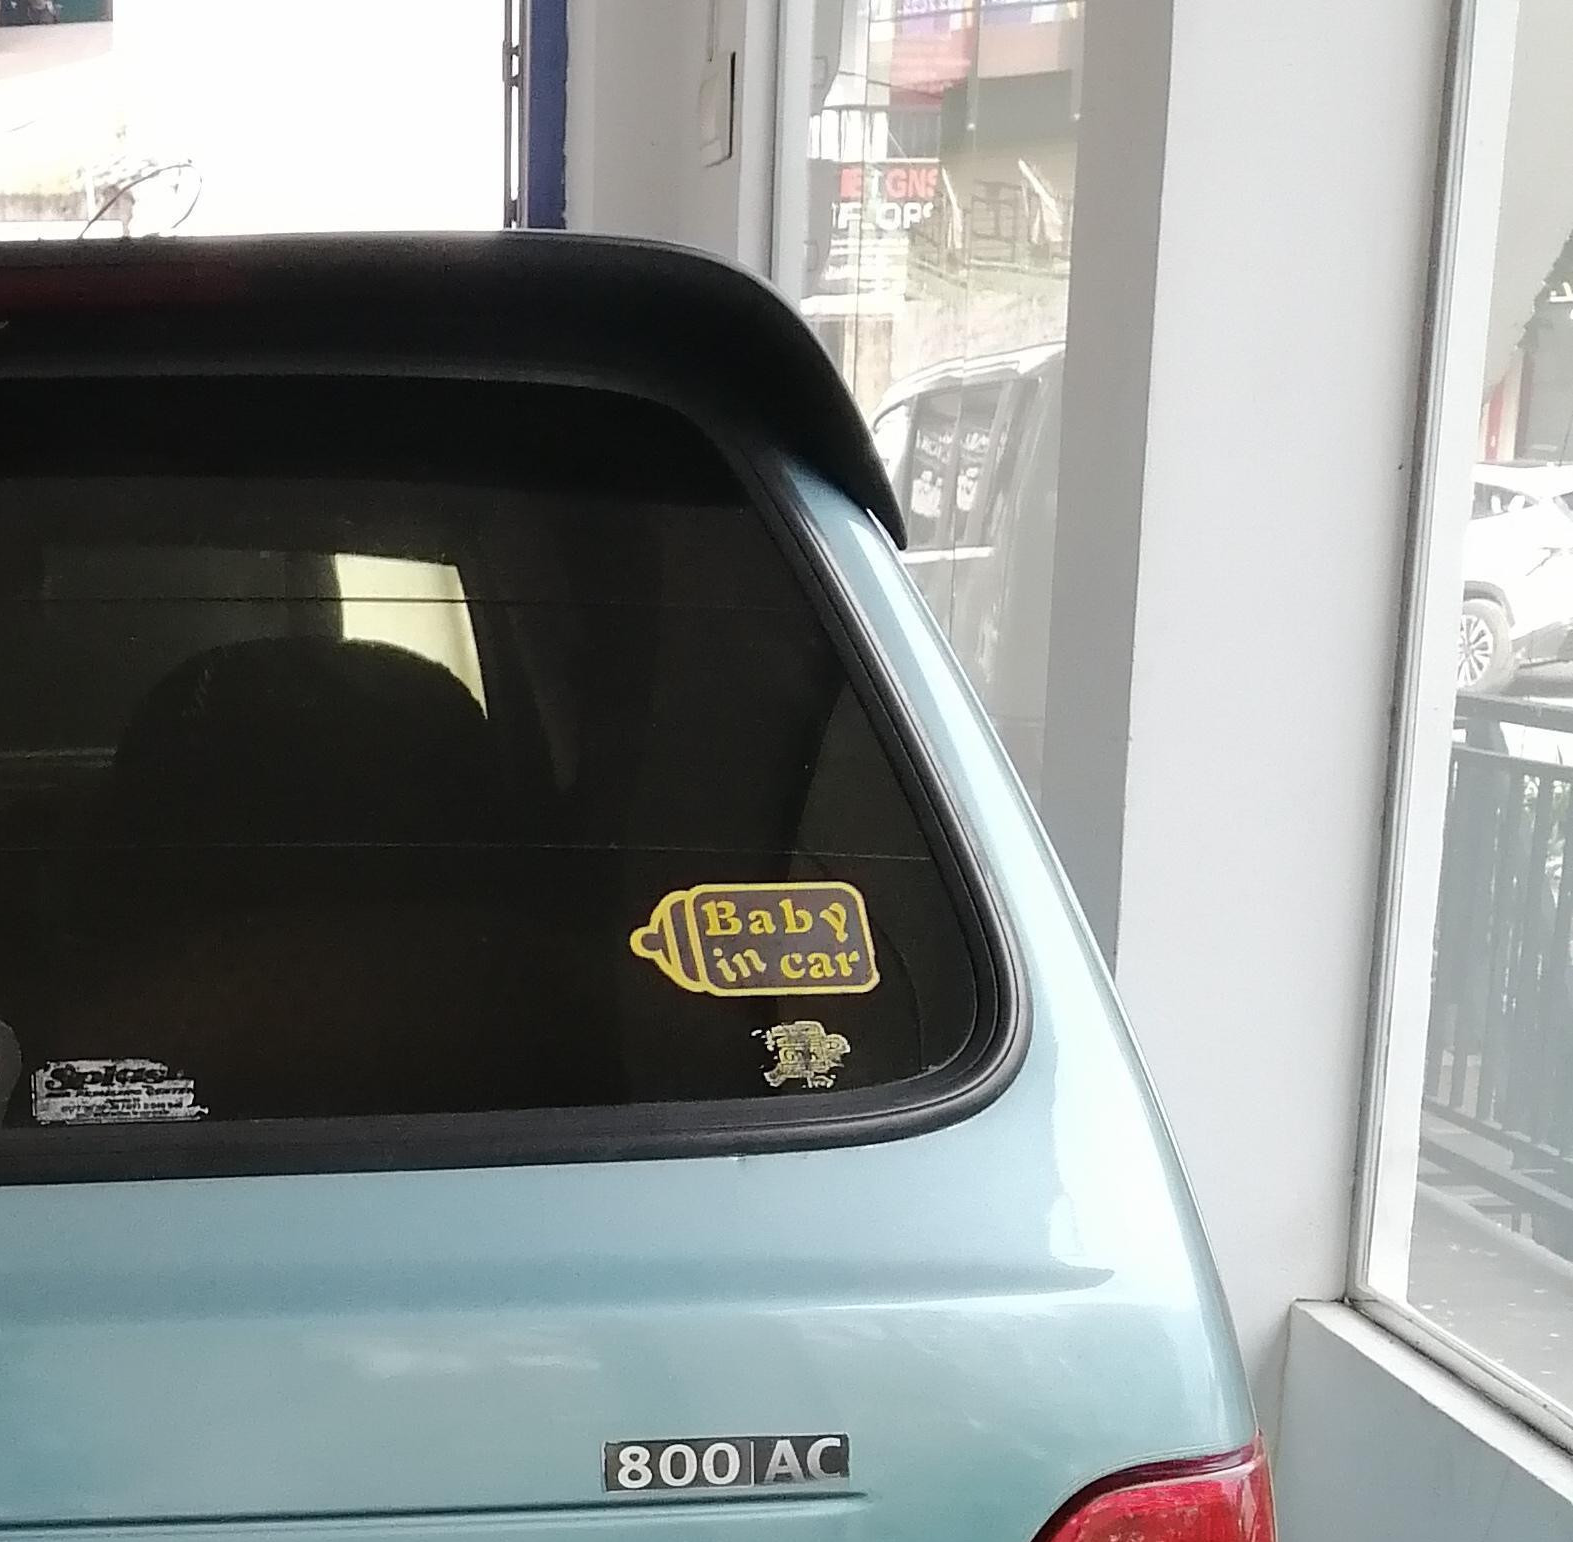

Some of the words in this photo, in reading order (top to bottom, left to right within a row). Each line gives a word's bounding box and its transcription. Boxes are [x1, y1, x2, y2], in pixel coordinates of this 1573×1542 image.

[701, 898, 849, 943] Baby
[712, 947, 767, 983] in
[780, 950, 861, 979] car
[616, 1442, 742, 1490] 800
[762, 1437, 842, 1485] AC
